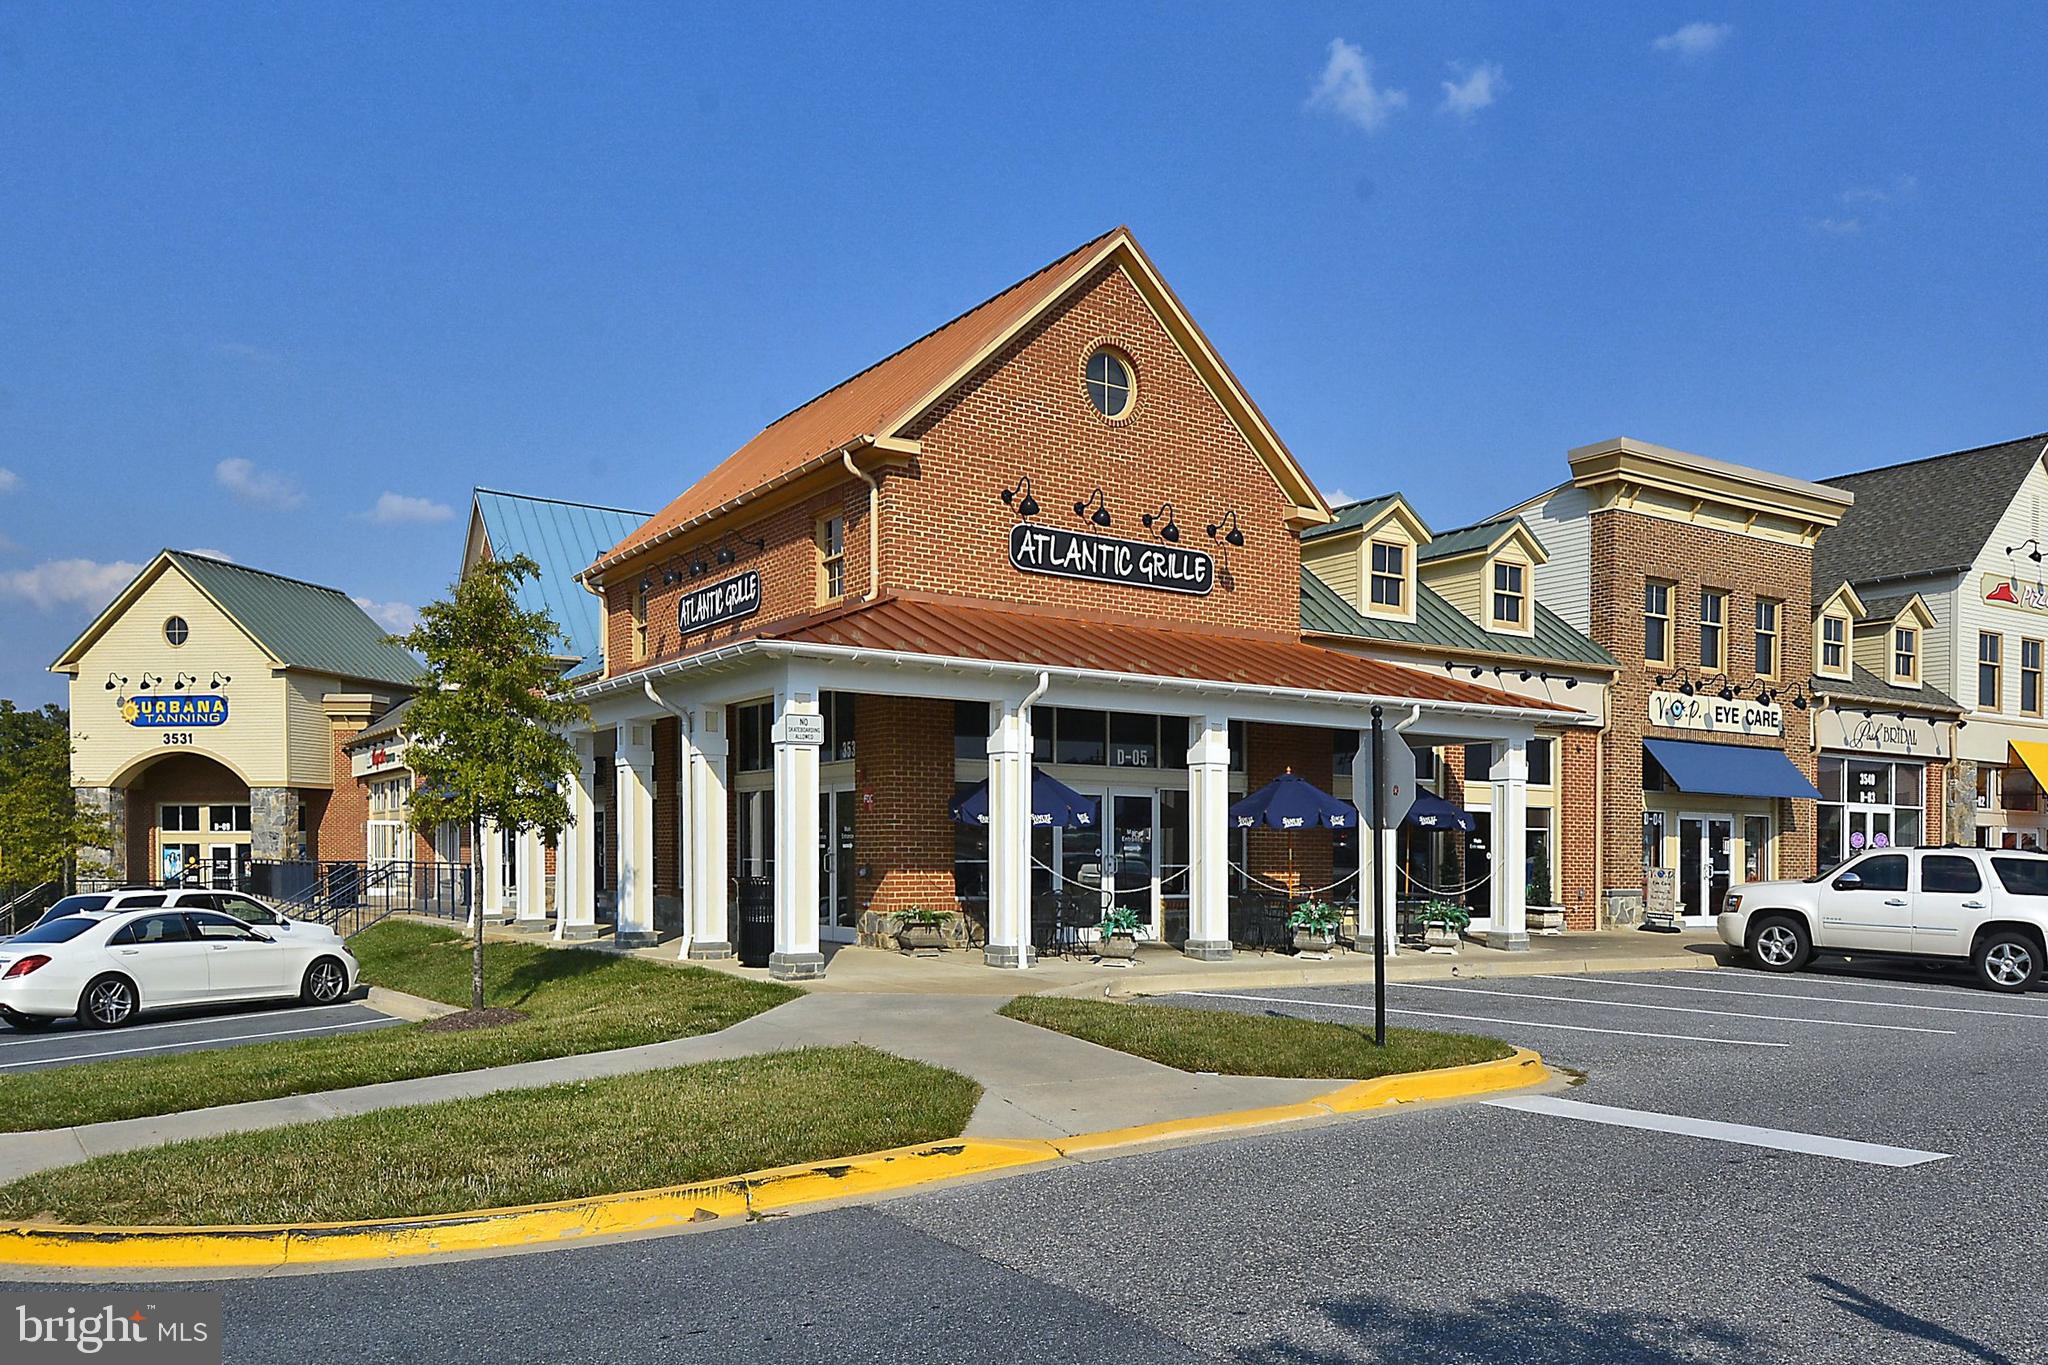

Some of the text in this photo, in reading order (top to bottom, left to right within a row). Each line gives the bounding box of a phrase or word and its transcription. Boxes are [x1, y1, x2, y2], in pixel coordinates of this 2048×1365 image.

[1017, 530, 1206, 582] ATLANTIC GRILLE
[680, 574, 757, 627] ATLANTIC GRILLE
[141, 701, 224, 713] URBANA
[145, 713, 220, 722] TANNING
[799, 718, 809, 726] NO
[1715, 706, 1740, 724] EYE
[1745, 709, 1779, 728] CARE
[163, 733, 193, 745] 3531
[1883, 726, 1918, 746] BRIDAL
[1117, 749, 1148, 766] D-05
